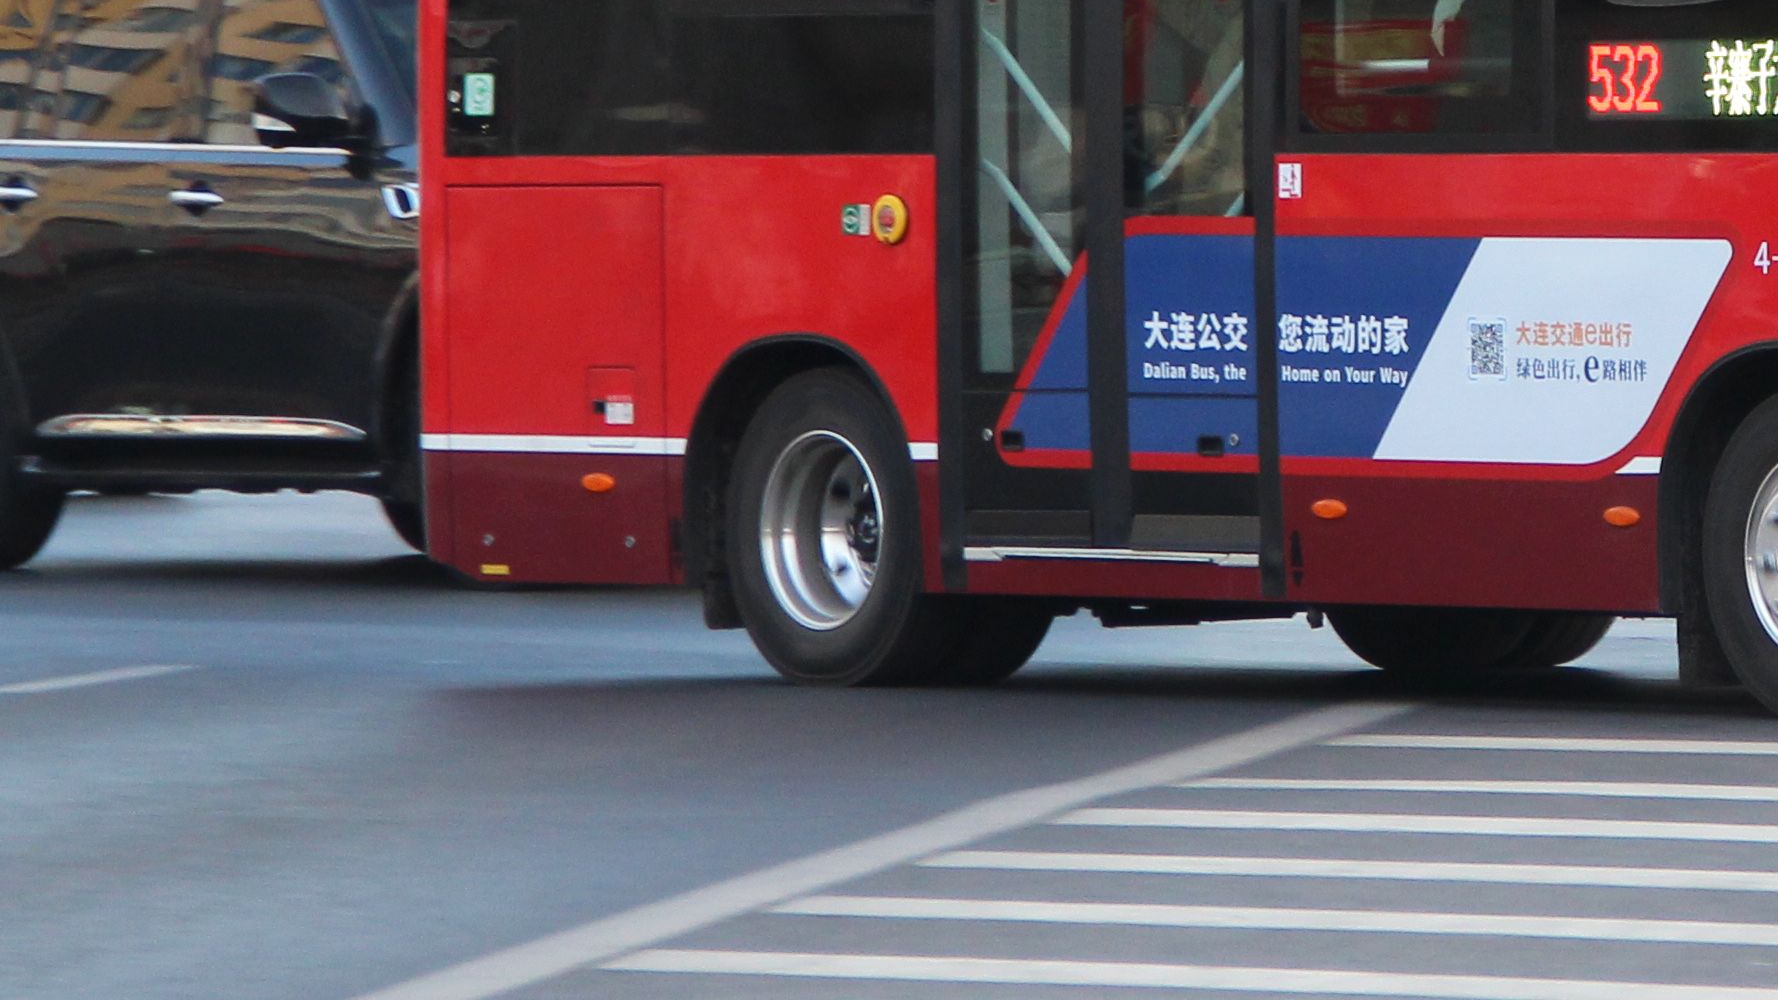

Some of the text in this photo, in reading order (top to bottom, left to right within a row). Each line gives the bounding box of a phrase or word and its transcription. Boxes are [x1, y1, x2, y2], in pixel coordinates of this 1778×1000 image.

[1587, 44, 1662, 113] 532
[1143, 311, 1410, 355] 大连公交 您流动的家
[1515, 320, 1633, 348] 大连交通e出行
[1143, 361, 1408, 388] Dalian Bus, the Home on Your Way
